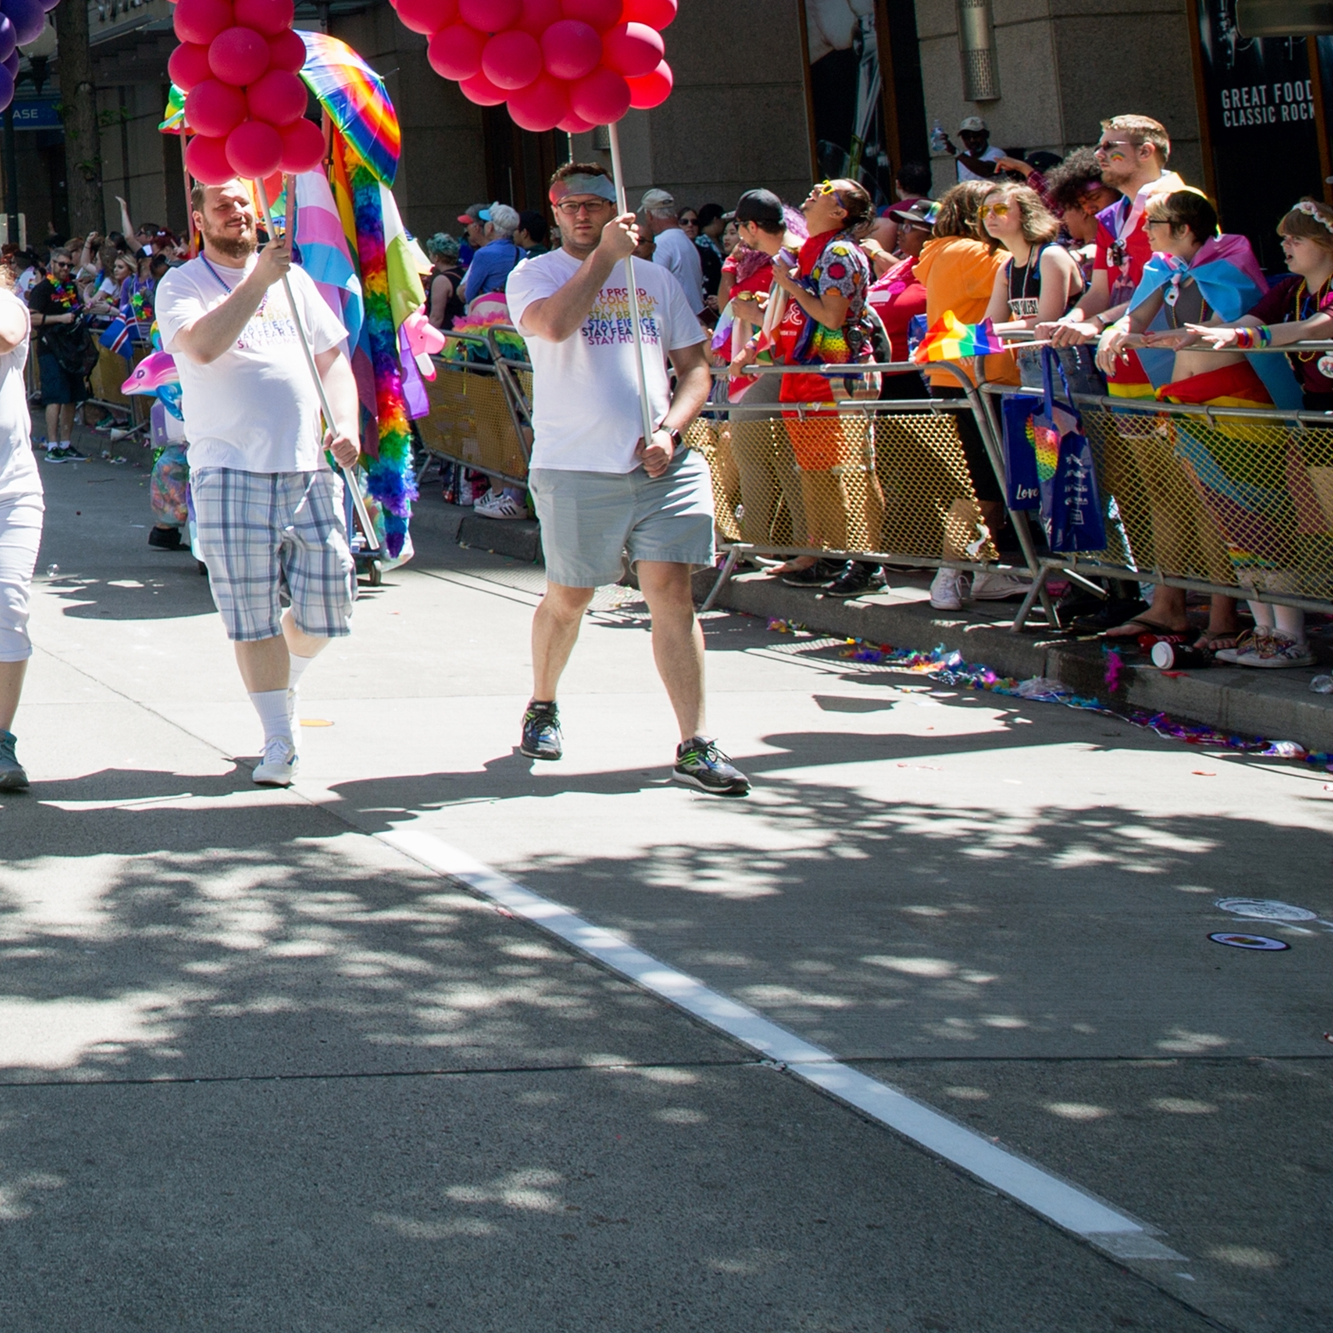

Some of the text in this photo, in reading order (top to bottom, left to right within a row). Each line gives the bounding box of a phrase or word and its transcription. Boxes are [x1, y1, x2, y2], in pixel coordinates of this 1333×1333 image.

[1221, 85, 1267, 109] GREAT
[1223, 106, 1276, 128] CLASSIC
[599, 295, 659, 305] COLOFUL
[588, 310, 652, 320] STAY BRVE
[588, 318, 655, 329] STAY FIECE
[582, 327, 608, 337] STAY
[588, 336, 614, 346] STAY
[1016, 484, 1039, 501] Love
